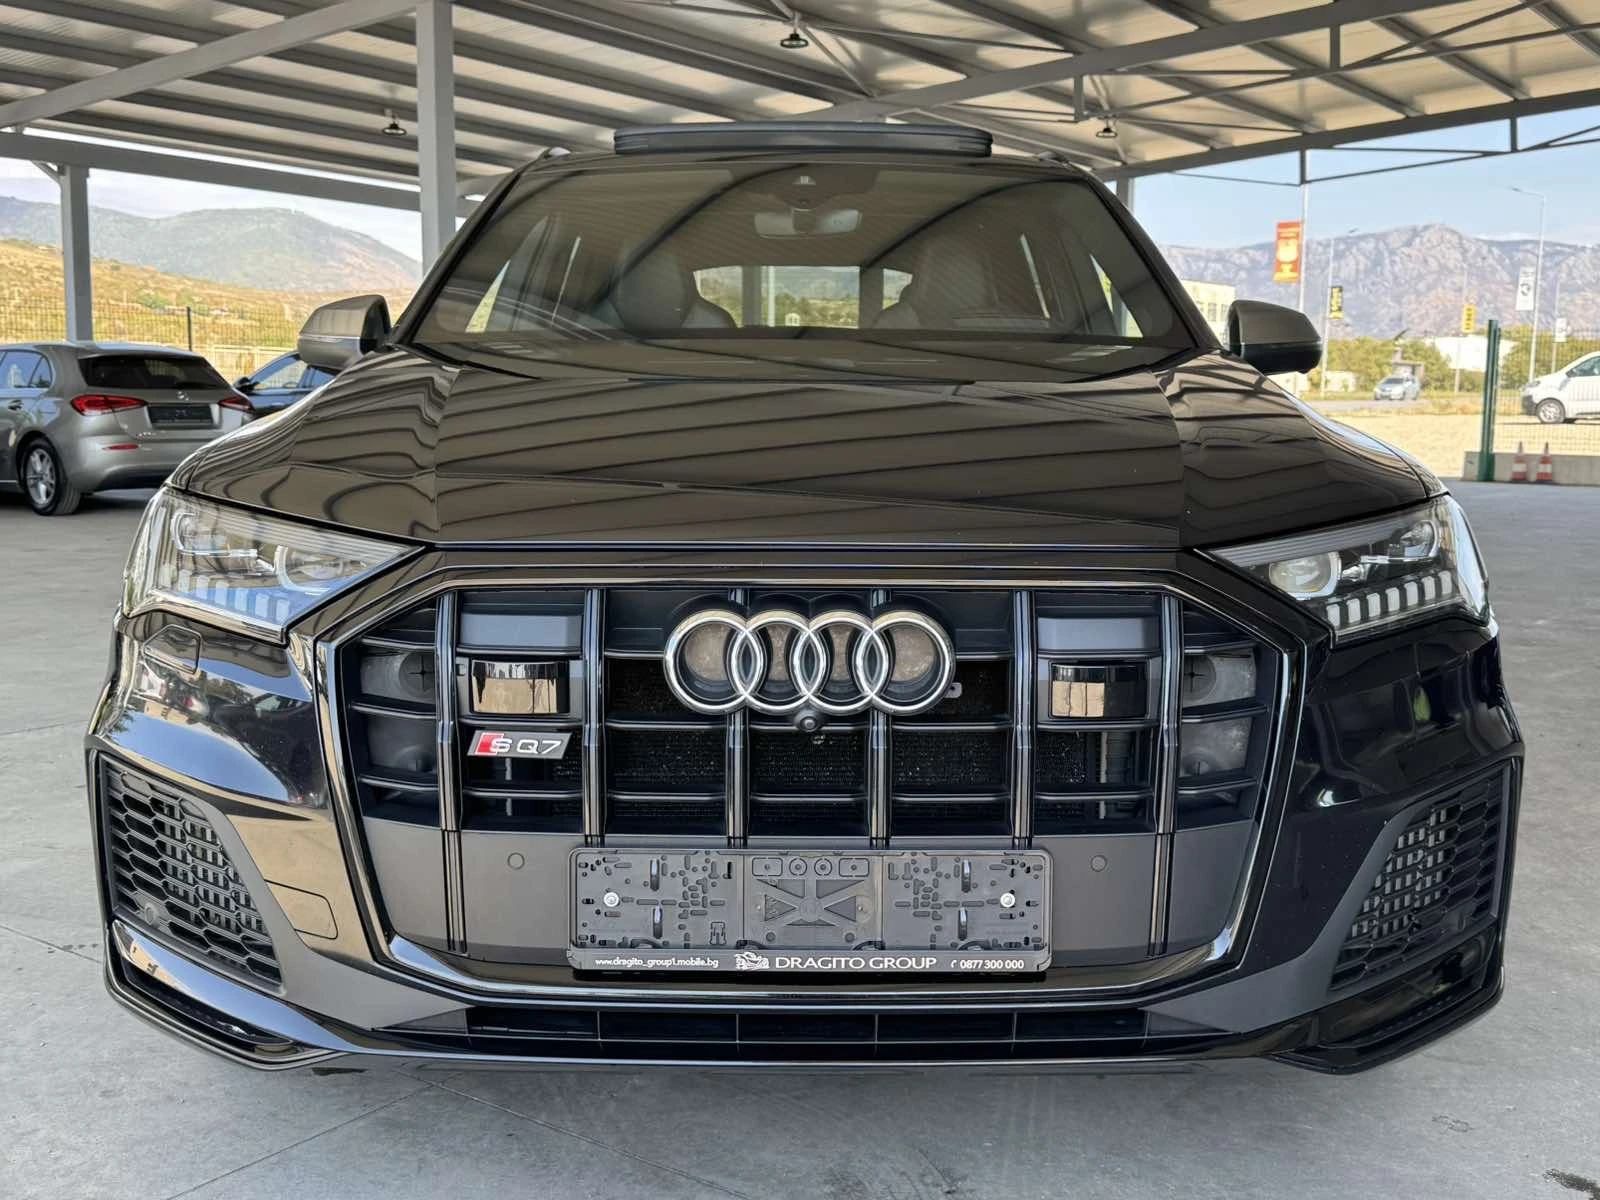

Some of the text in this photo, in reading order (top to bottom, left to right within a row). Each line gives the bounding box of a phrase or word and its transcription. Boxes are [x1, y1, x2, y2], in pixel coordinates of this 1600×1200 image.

[485, 736, 562, 755] SQ7
[775, 956, 937, 969] DRAGITO GROUP
[959, 959, 1025, 969] 0877 300 000
